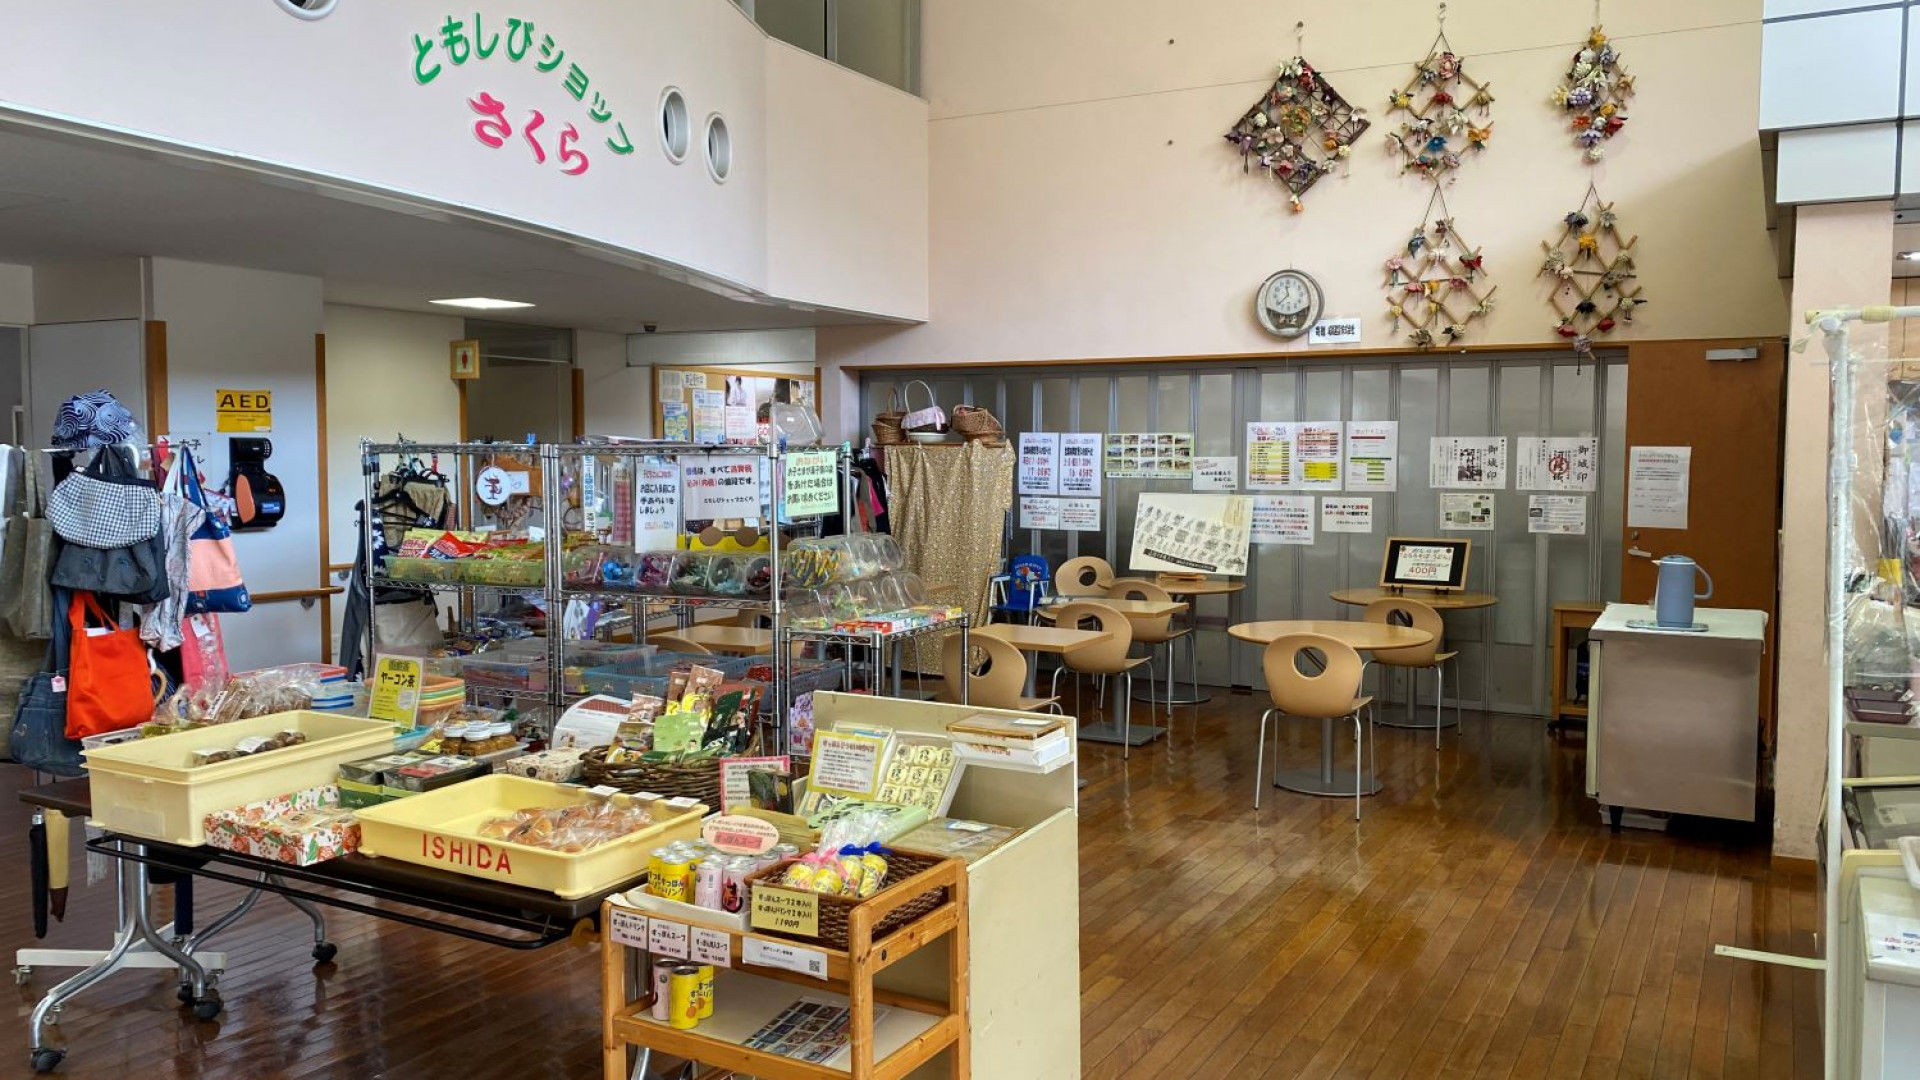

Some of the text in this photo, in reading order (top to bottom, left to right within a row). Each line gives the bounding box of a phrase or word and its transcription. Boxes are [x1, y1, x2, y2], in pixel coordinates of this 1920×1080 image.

[412, 12, 634, 155] ともしびショップ
[468, 91, 590, 175] さくら
[219, 393, 269, 409] AED
[1487, 445, 1498, 480] 御城印
[1577, 445, 1589, 482] 御城印
[381, 672, 416, 688] ヤーコン茶
[421, 833, 512, 875] ISHIDA
[775, 918, 800, 928] 1190円
